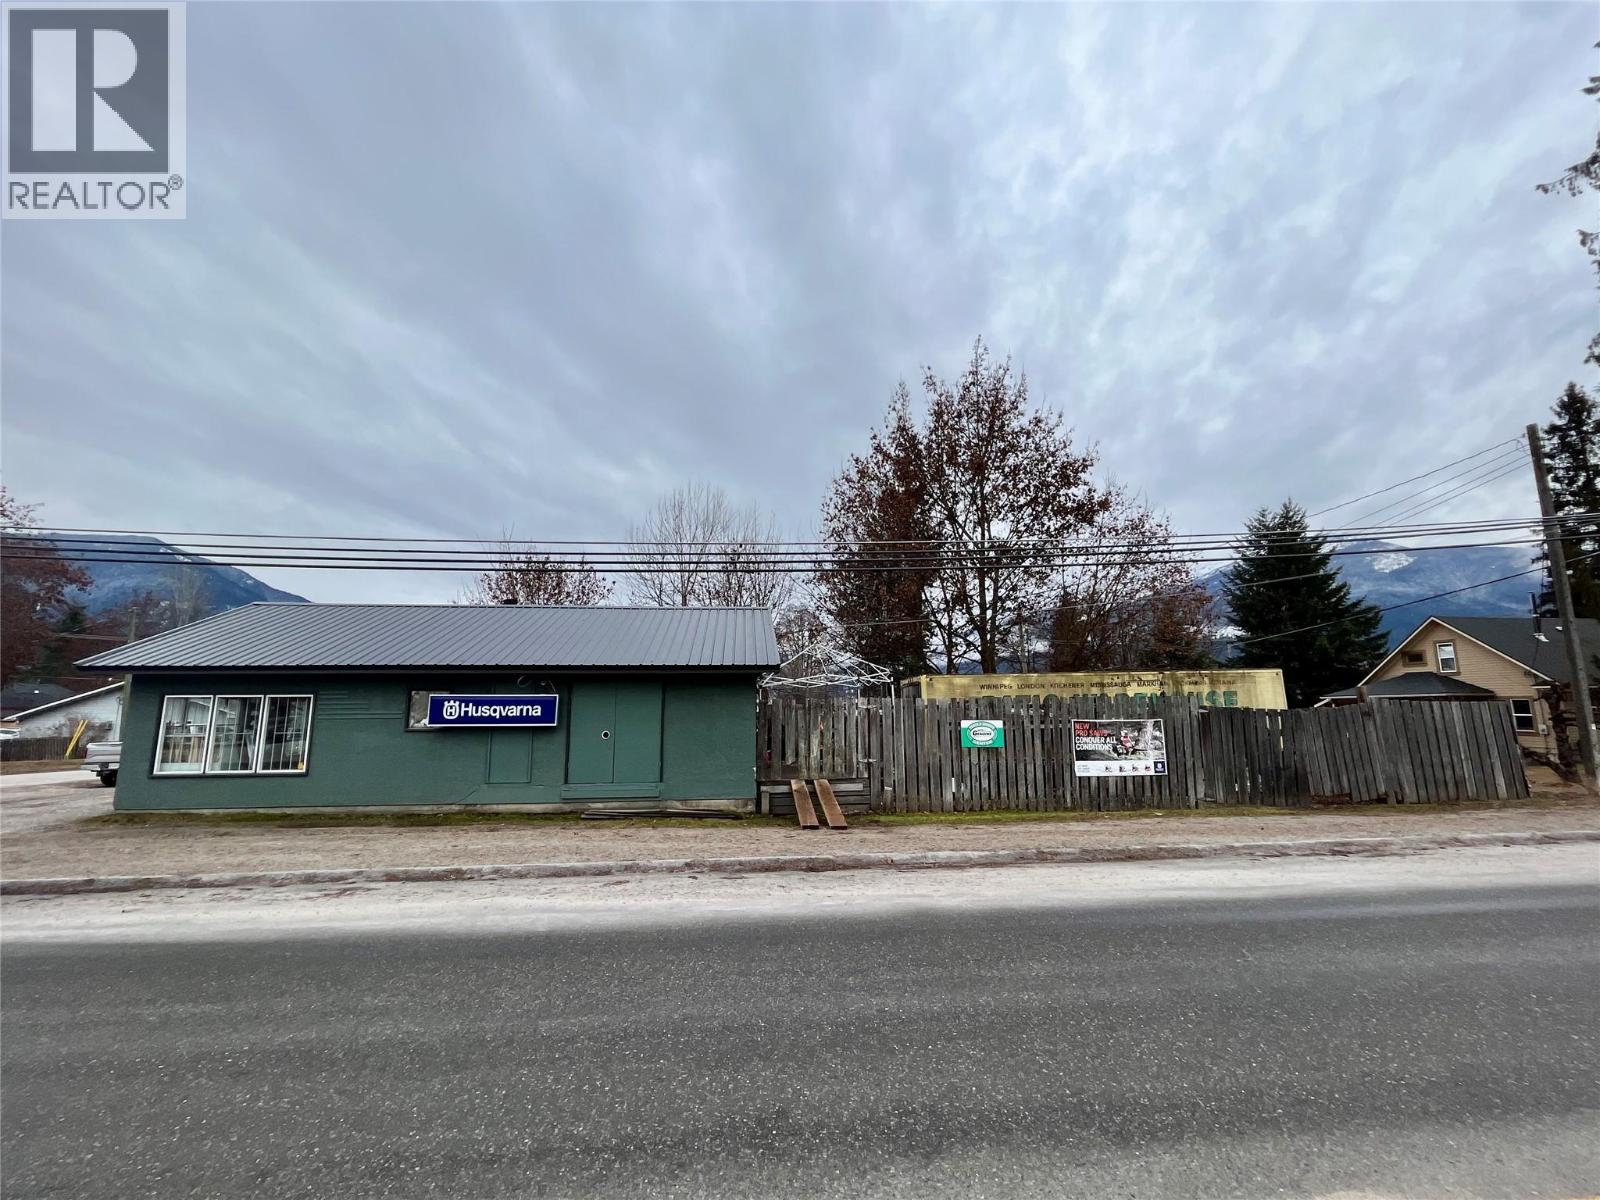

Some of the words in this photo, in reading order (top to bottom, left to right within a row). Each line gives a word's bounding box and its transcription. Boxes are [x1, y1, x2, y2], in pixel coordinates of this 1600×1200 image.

[461, 702, 542, 719] Husqvarna
[1074, 722, 1090, 730] NEW
[1075, 736, 1105, 744] CONQUER
[1106, 736, 1117, 744] ALL
[1075, 743, 1113, 751] CONDITIONS
